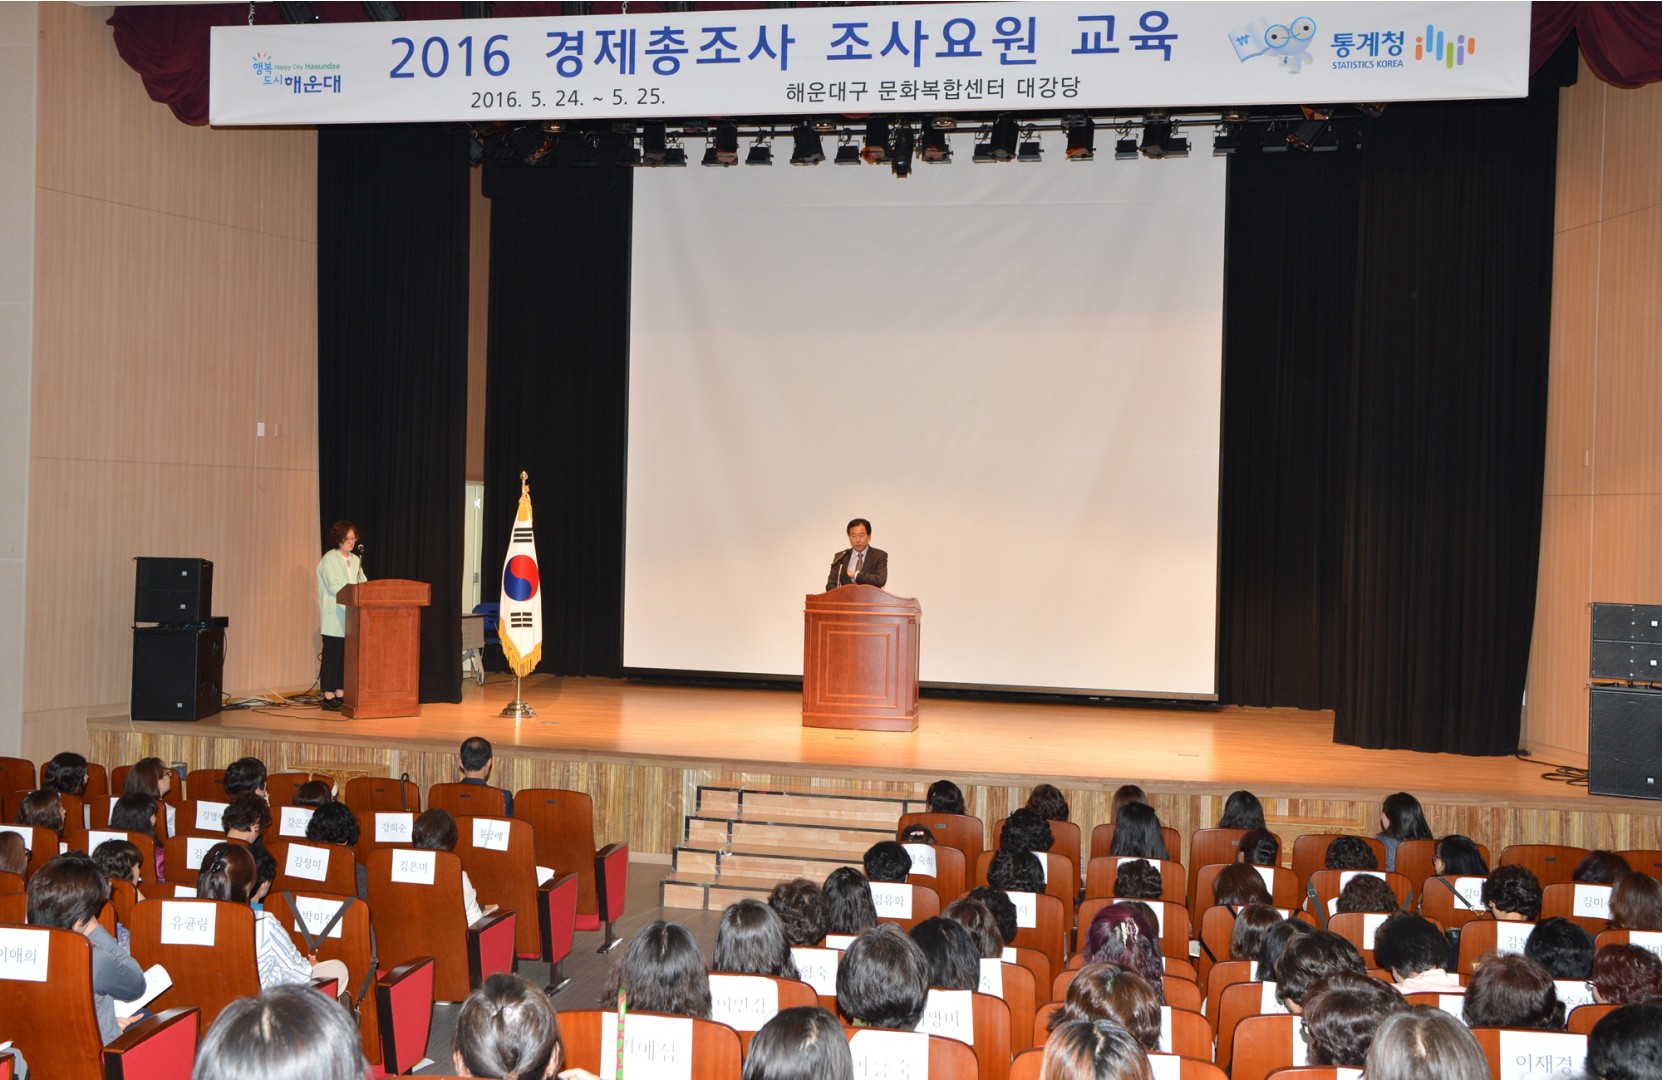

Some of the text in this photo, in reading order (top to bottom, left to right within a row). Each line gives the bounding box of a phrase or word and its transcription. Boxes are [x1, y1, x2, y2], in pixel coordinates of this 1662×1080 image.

[389, 10, 1179, 79] 2016 경제총조사 조사요원 교육
[1330, 30, 1405, 59] 통계청
[252, 61, 273, 76] 행복
[304, 62, 341, 70] Haeundae
[1332, 59, 1404, 70] STATISTICS KOREA
[263, 74, 341, 94] 도시 해운대
[786, 75, 1081, 104] 해운대구 문화복합센터 대강당
[470, 90, 522, 109] 2016.
[531, 90, 546, 108] 5.
[555, 89, 584, 107] 24.
[612, 88, 628, 106] 5.
[636, 87, 666, 105] 25.
[293, 855, 322, 872] 김정미
[399, 860, 428, 874] 김은미
[171, 916, 208, 933] 유균림
[1515, 1053, 1573, 1077] 이재경
